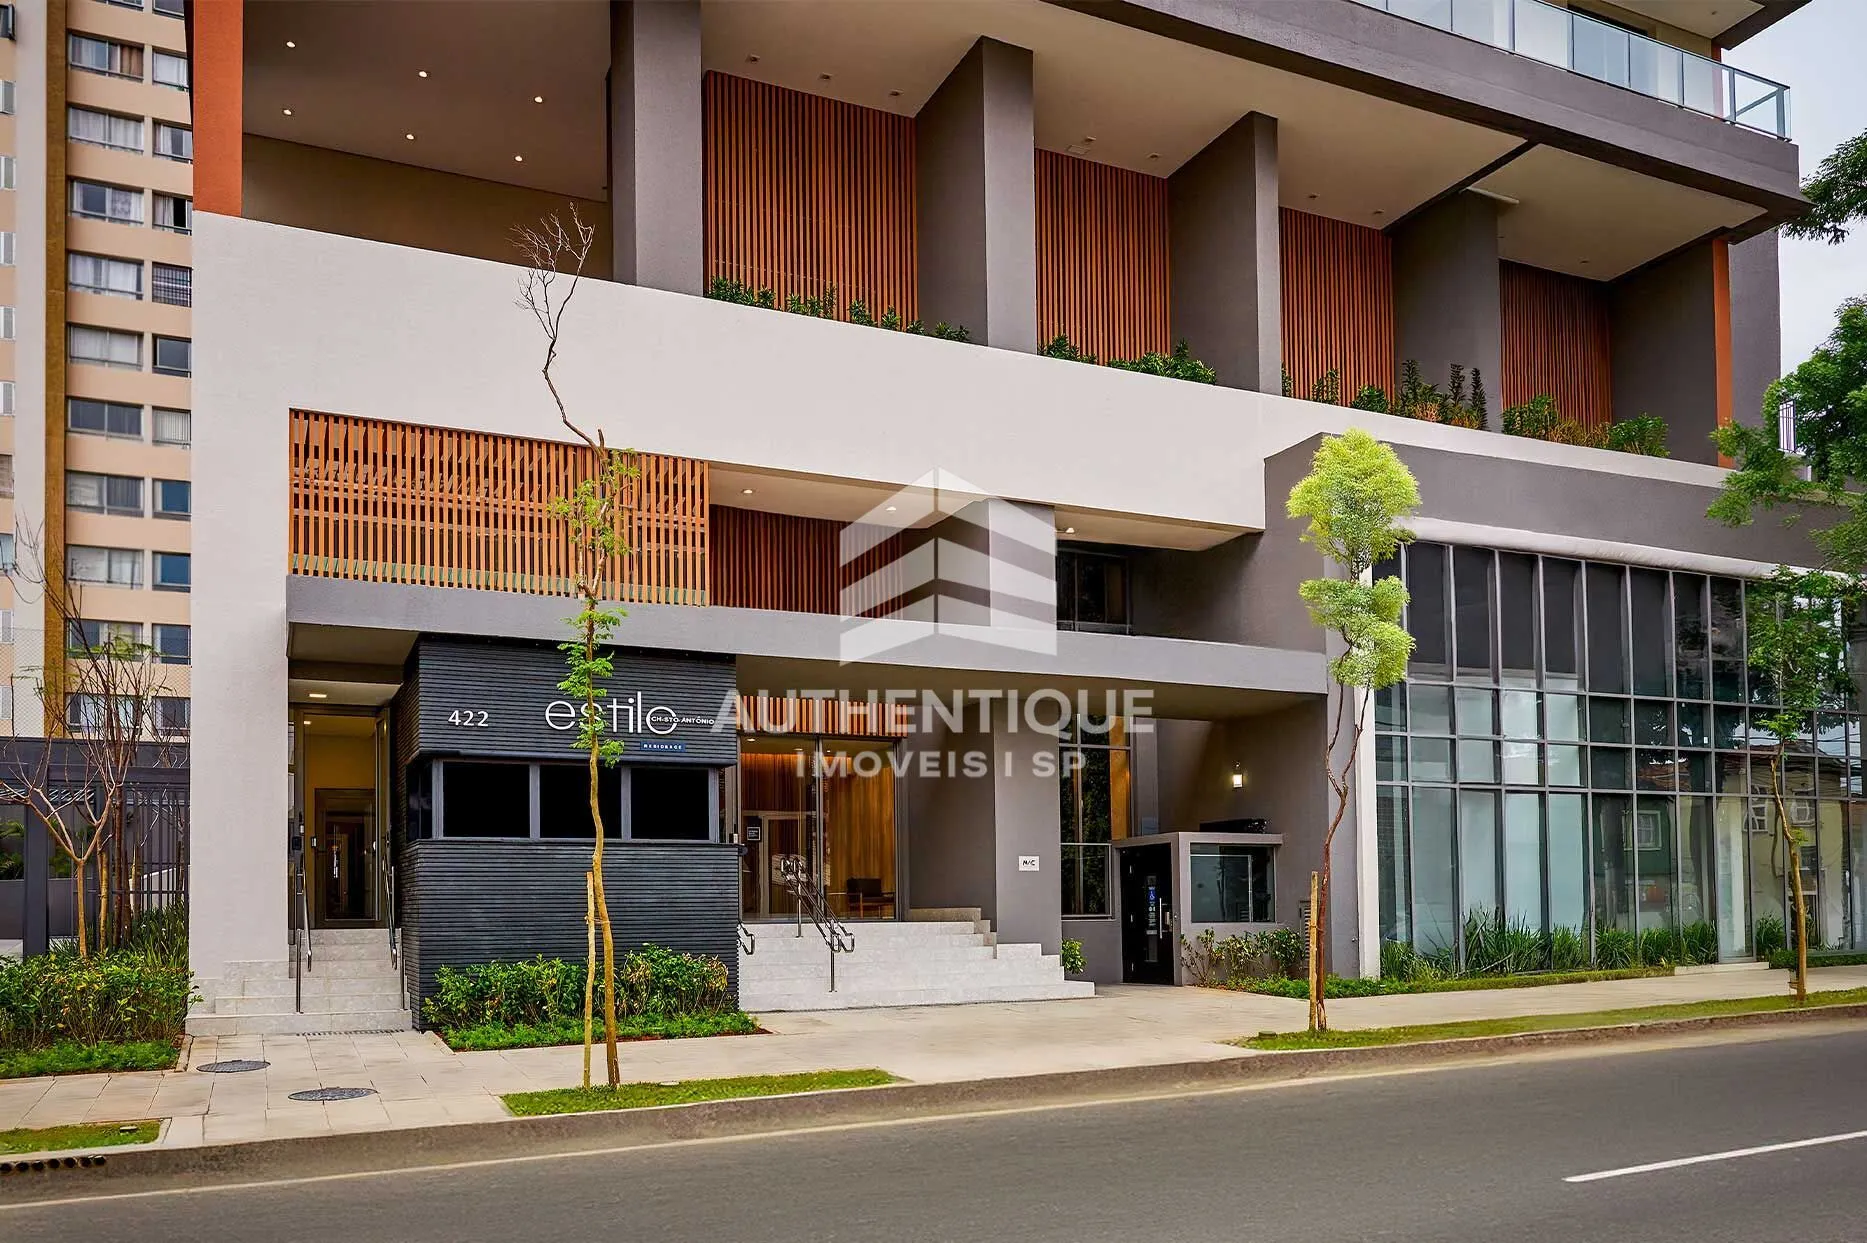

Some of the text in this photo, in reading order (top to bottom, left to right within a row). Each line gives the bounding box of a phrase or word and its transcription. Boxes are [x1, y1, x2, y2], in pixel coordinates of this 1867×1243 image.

[448, 710, 489, 727] 422
[544, 691, 678, 734] estilo
[681, 716, 715, 725] ANTÔNIO
